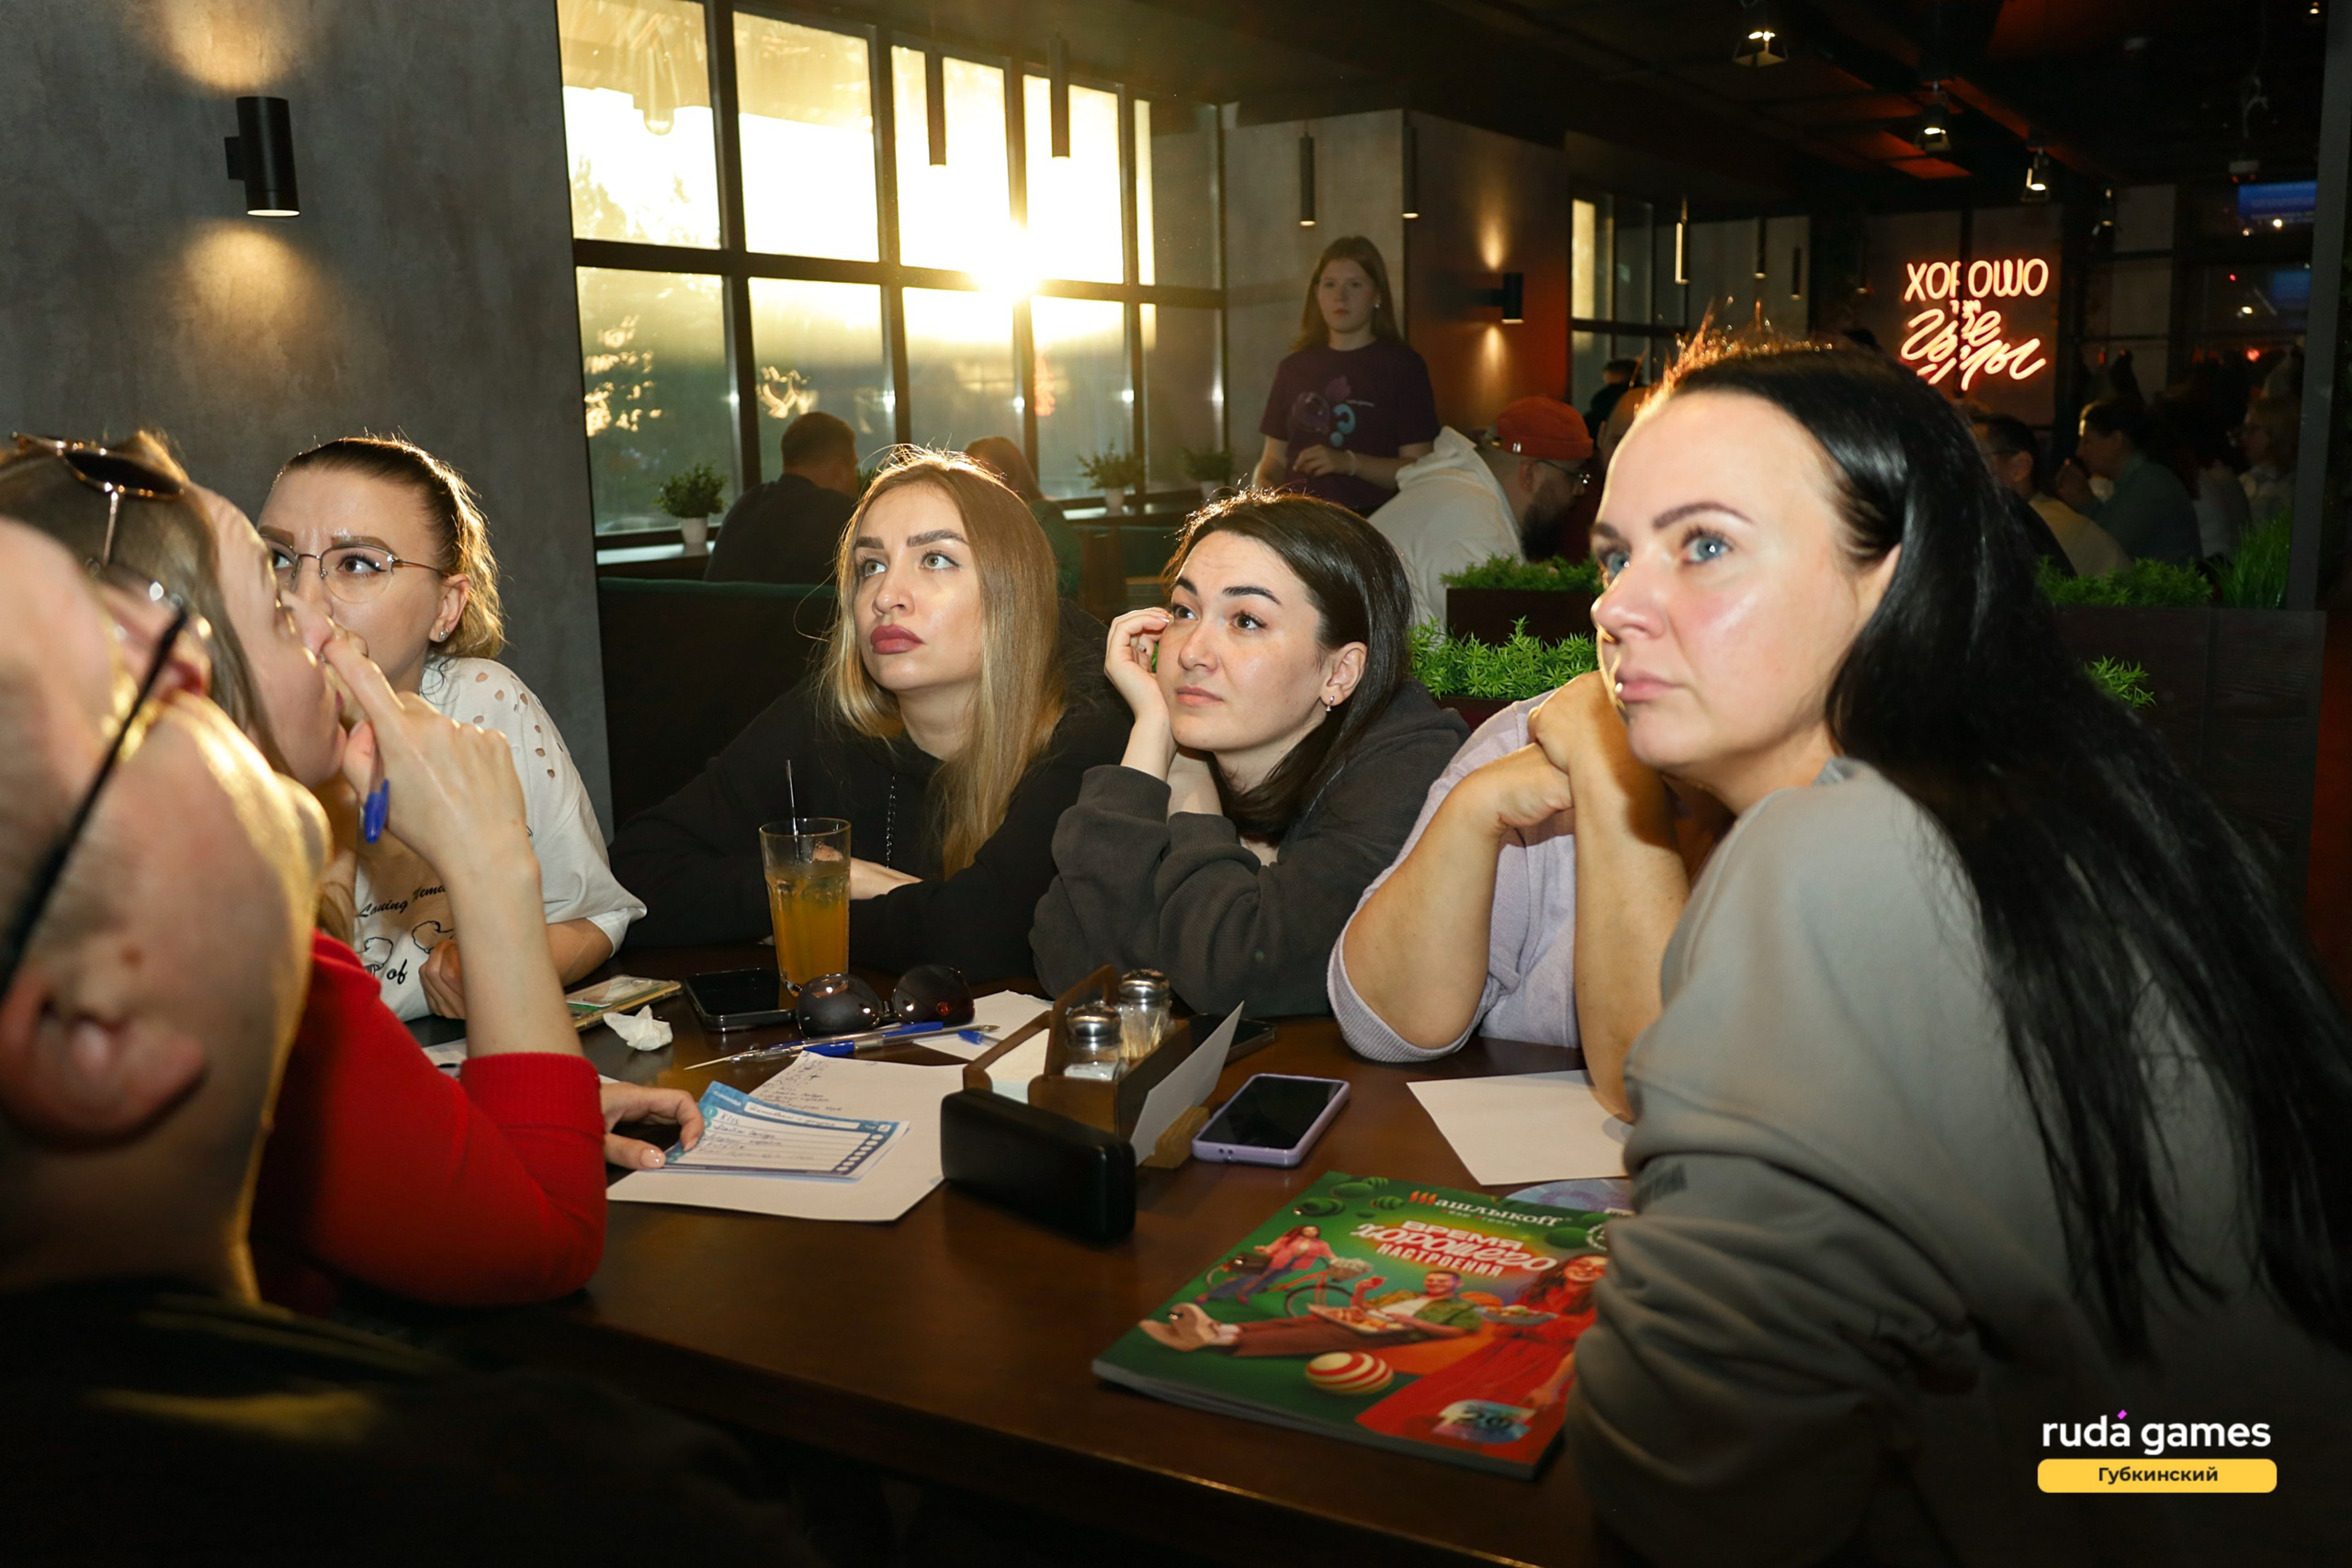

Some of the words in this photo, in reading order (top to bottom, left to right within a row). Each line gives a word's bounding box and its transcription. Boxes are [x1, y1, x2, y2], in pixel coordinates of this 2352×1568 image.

[387, 958, 407, 985] of
[1401, 1220, 1525, 1250] ВРЕМЯ
[1376, 1243, 1505, 1279] НАСТРОЕНИЯ
